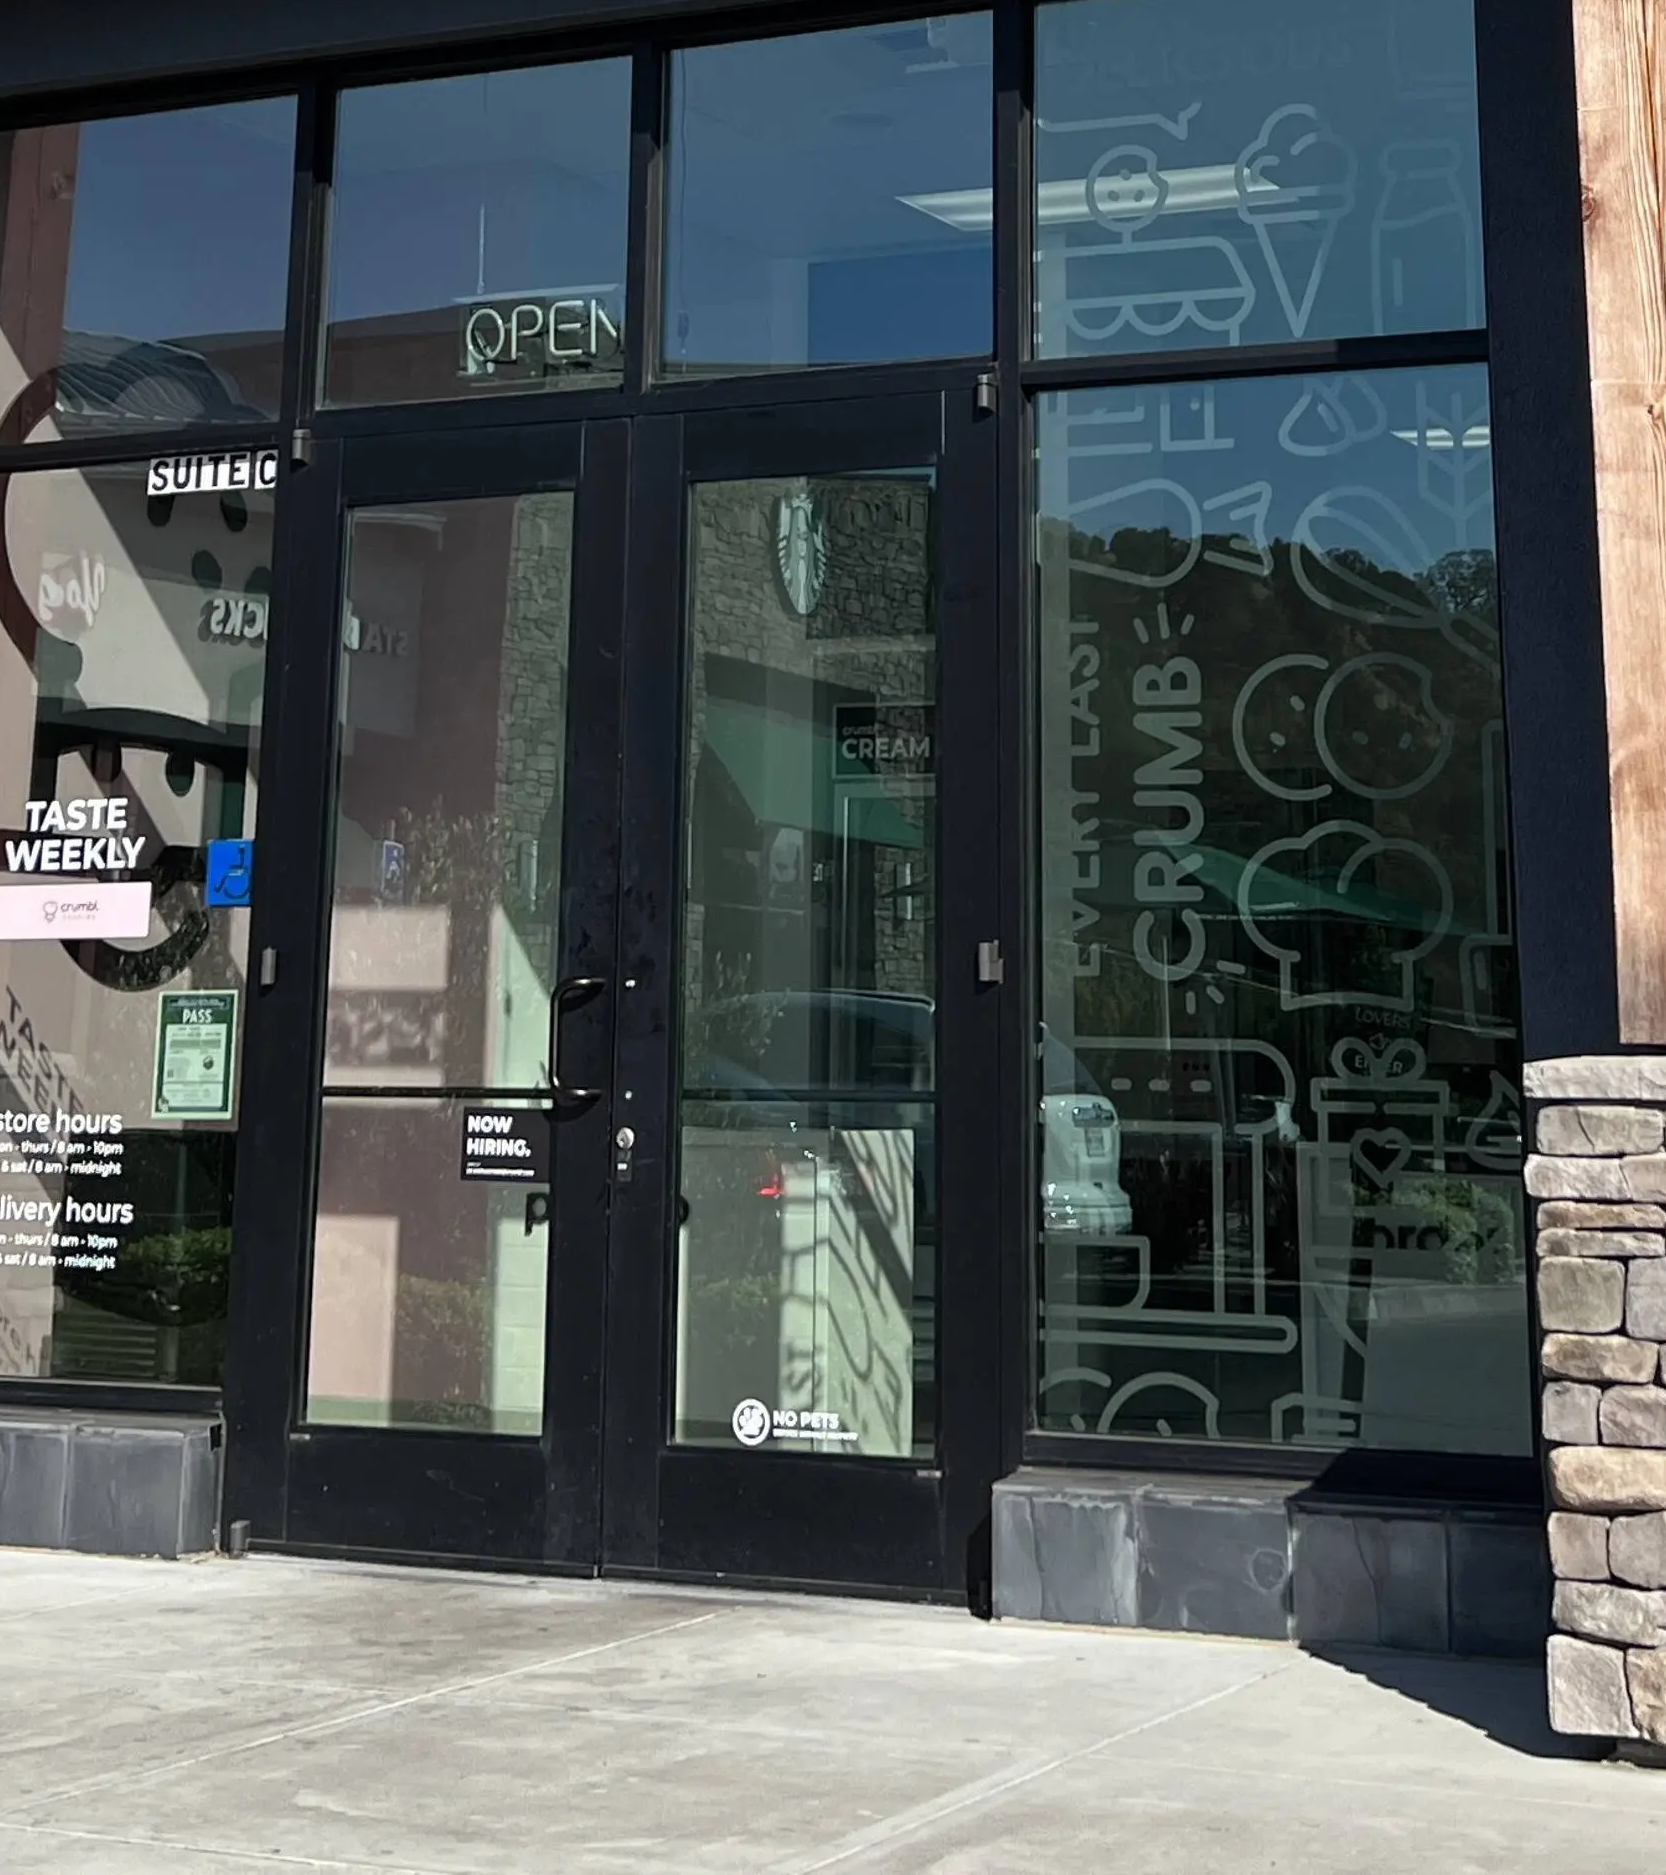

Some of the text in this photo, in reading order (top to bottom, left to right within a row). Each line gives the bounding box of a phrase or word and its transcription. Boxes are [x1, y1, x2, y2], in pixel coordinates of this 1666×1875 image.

[465, 299, 619, 361] OPEN
[151, 452, 278, 492] SUITE C
[840, 736, 931, 760] CREAM
[25, 797, 129, 833] TASTE
[1131, 655, 1207, 982] CRUMB
[4, 835, 147, 873] WEEKLY
[181, 1008, 213, 1024] PASS
[55, 1107, 123, 1135] hours
[467, 1114, 514, 1134] NOW
[65, 1195, 135, 1225] hours
[773, 1410, 840, 1430] NO PETS
